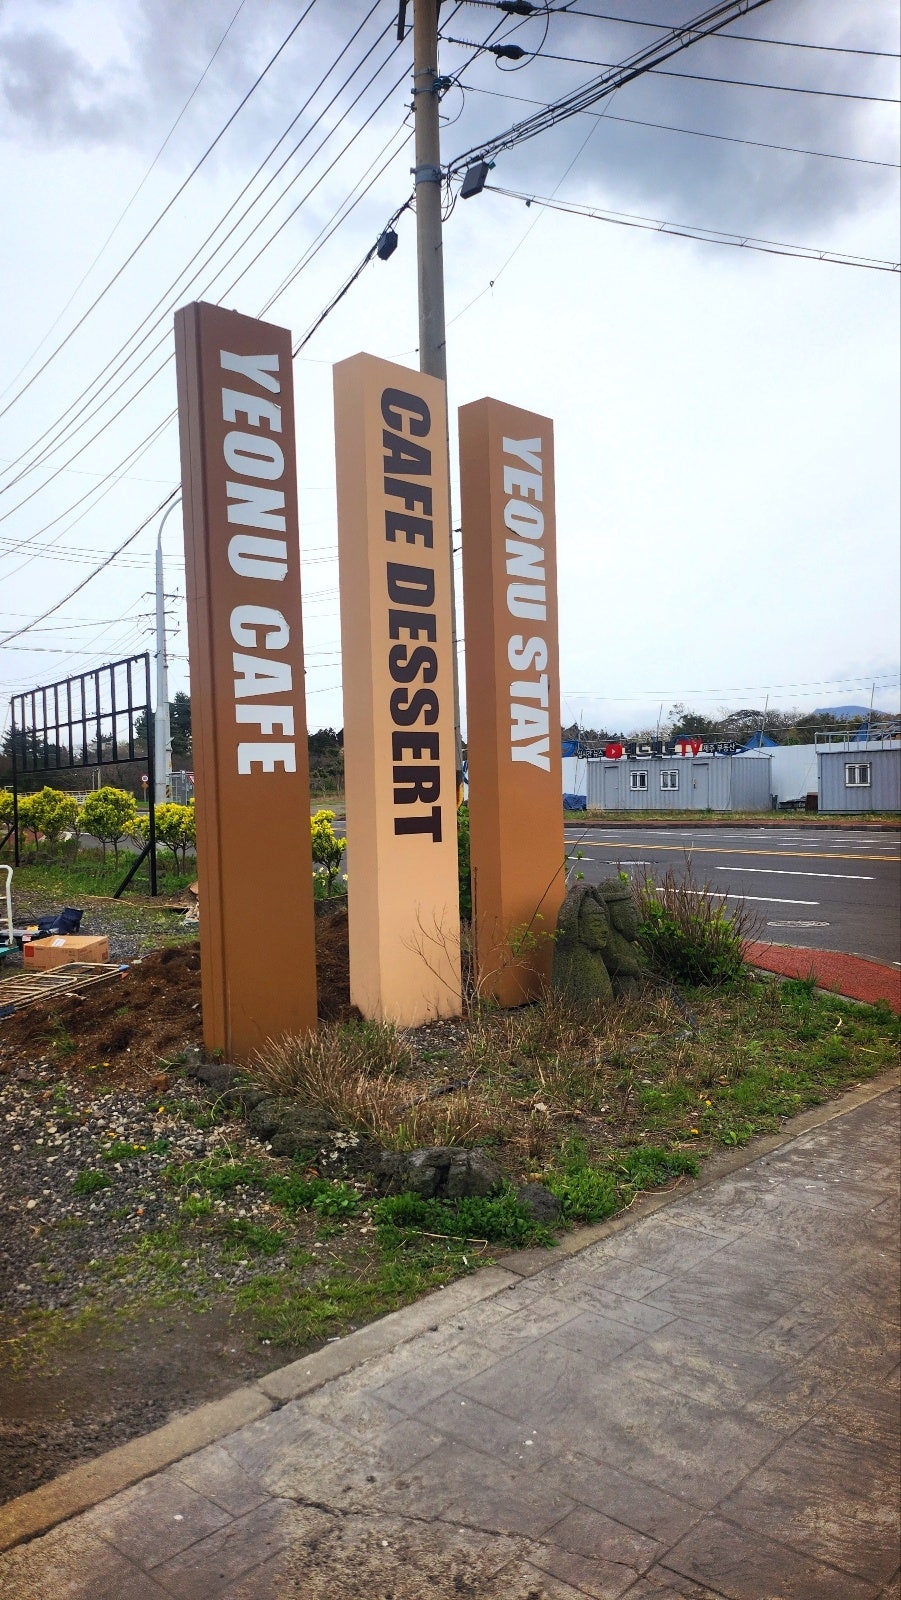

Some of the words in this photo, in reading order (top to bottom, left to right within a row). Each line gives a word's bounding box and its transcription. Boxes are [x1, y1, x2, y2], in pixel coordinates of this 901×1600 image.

[220, 350, 288, 582] YEONU
[381, 388, 433, 549] CAFE
[503, 437, 546, 621] YEONU
[230, 605, 296, 774] CAFE
[387, 562, 442, 842] DESSERT
[508, 635, 550, 772] STAY
